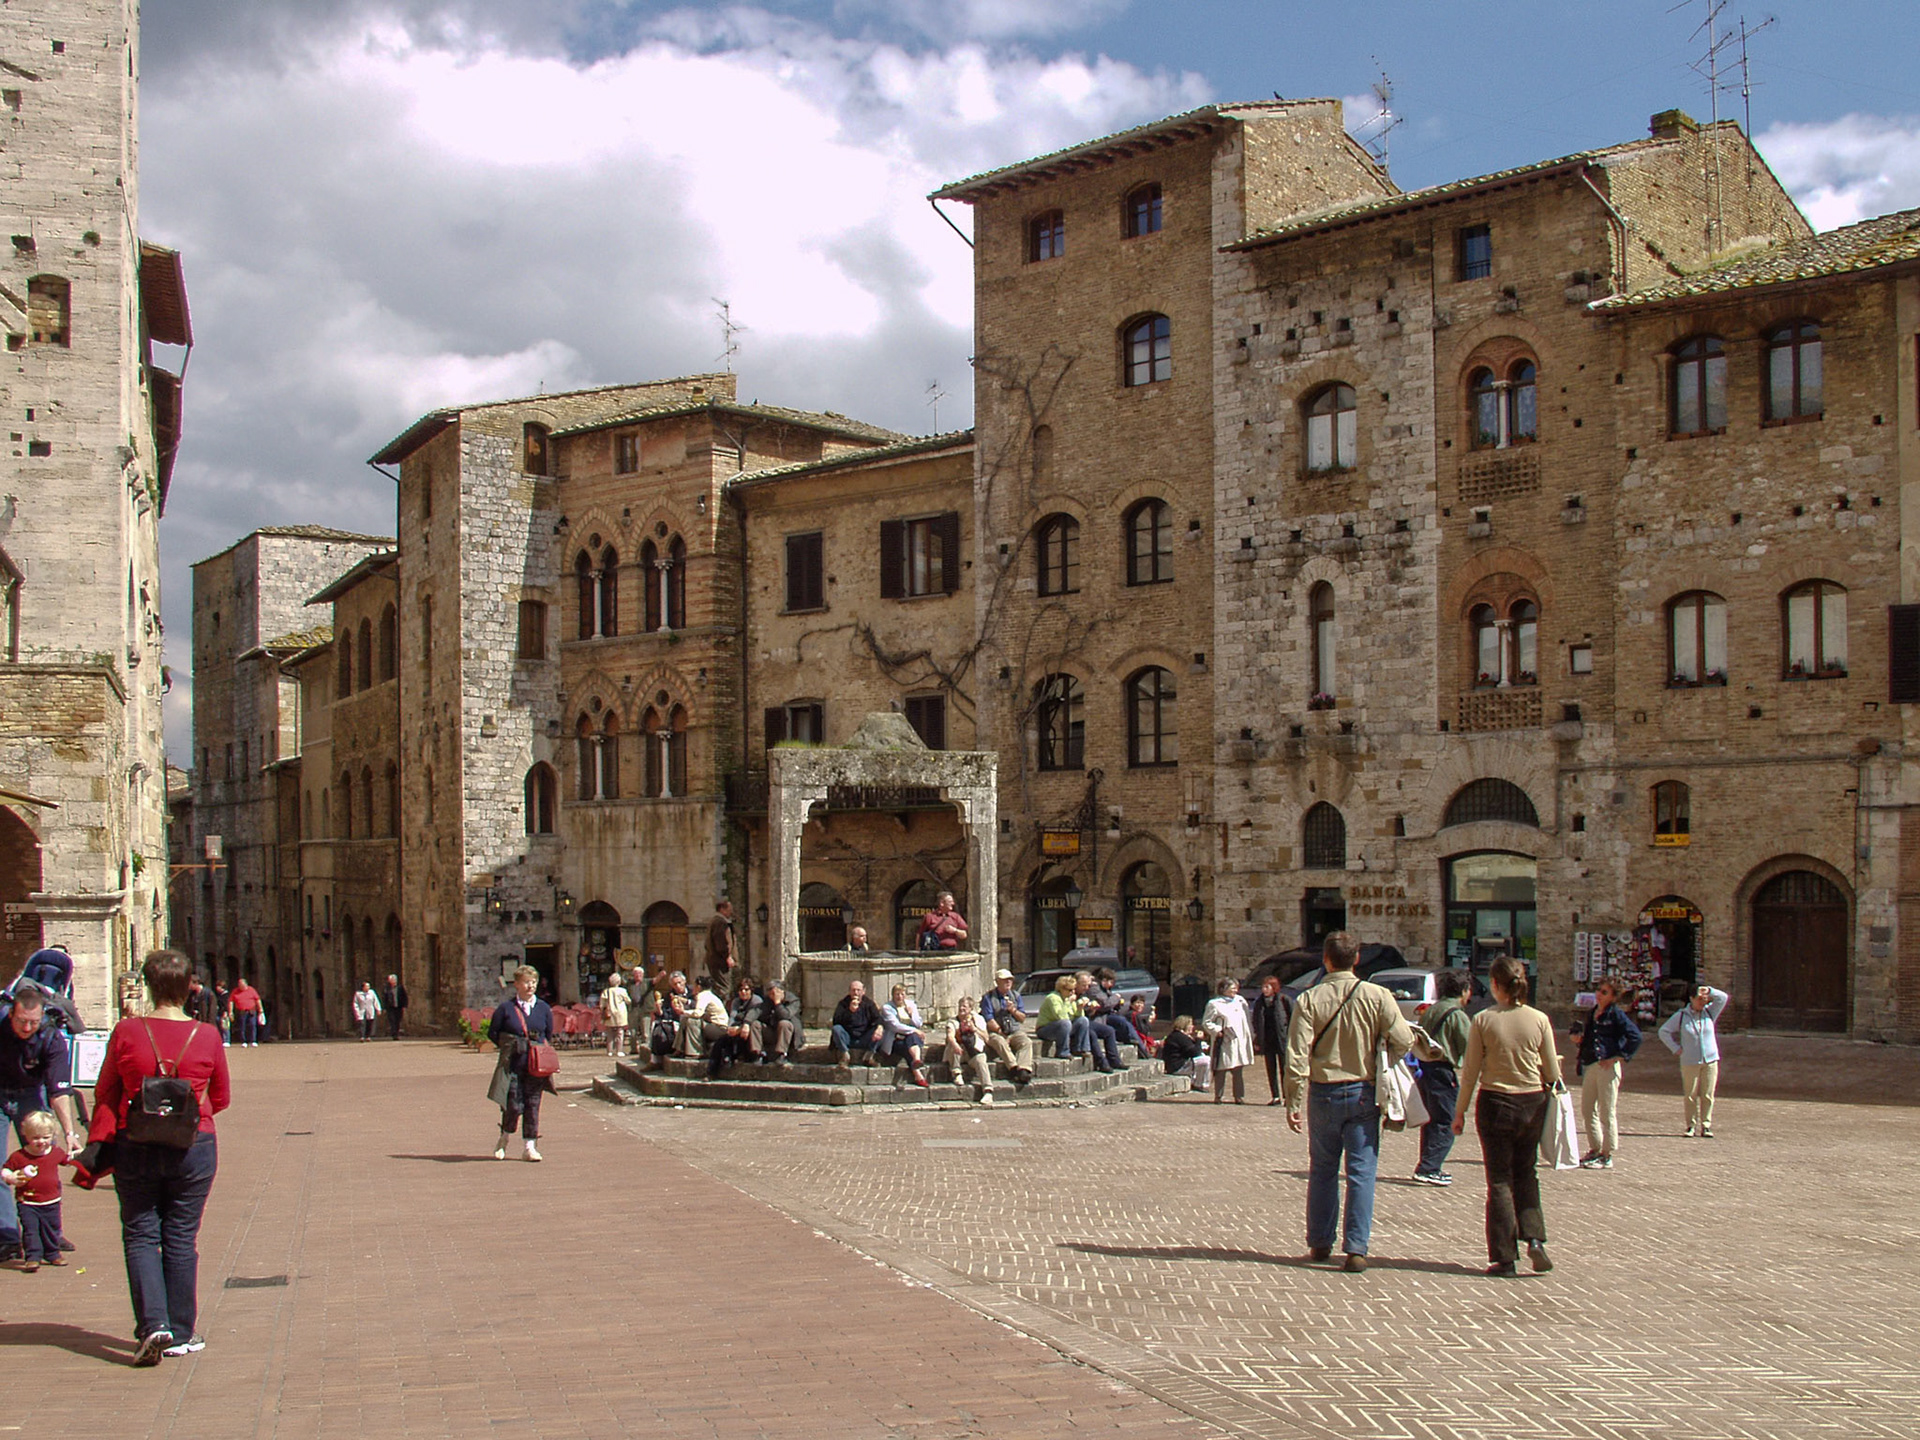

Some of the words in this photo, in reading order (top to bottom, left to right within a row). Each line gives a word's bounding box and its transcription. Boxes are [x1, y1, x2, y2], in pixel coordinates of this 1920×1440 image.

[1350, 886, 1406, 899] BANCA
[1037, 898, 1067, 909] ALBER
[1128, 897, 1171, 909] CISTERN
[798, 907, 841, 917] RISTORANT
[1349, 903, 1431, 916] TOSCANA
[1656, 908, 1685, 918] Kodak
